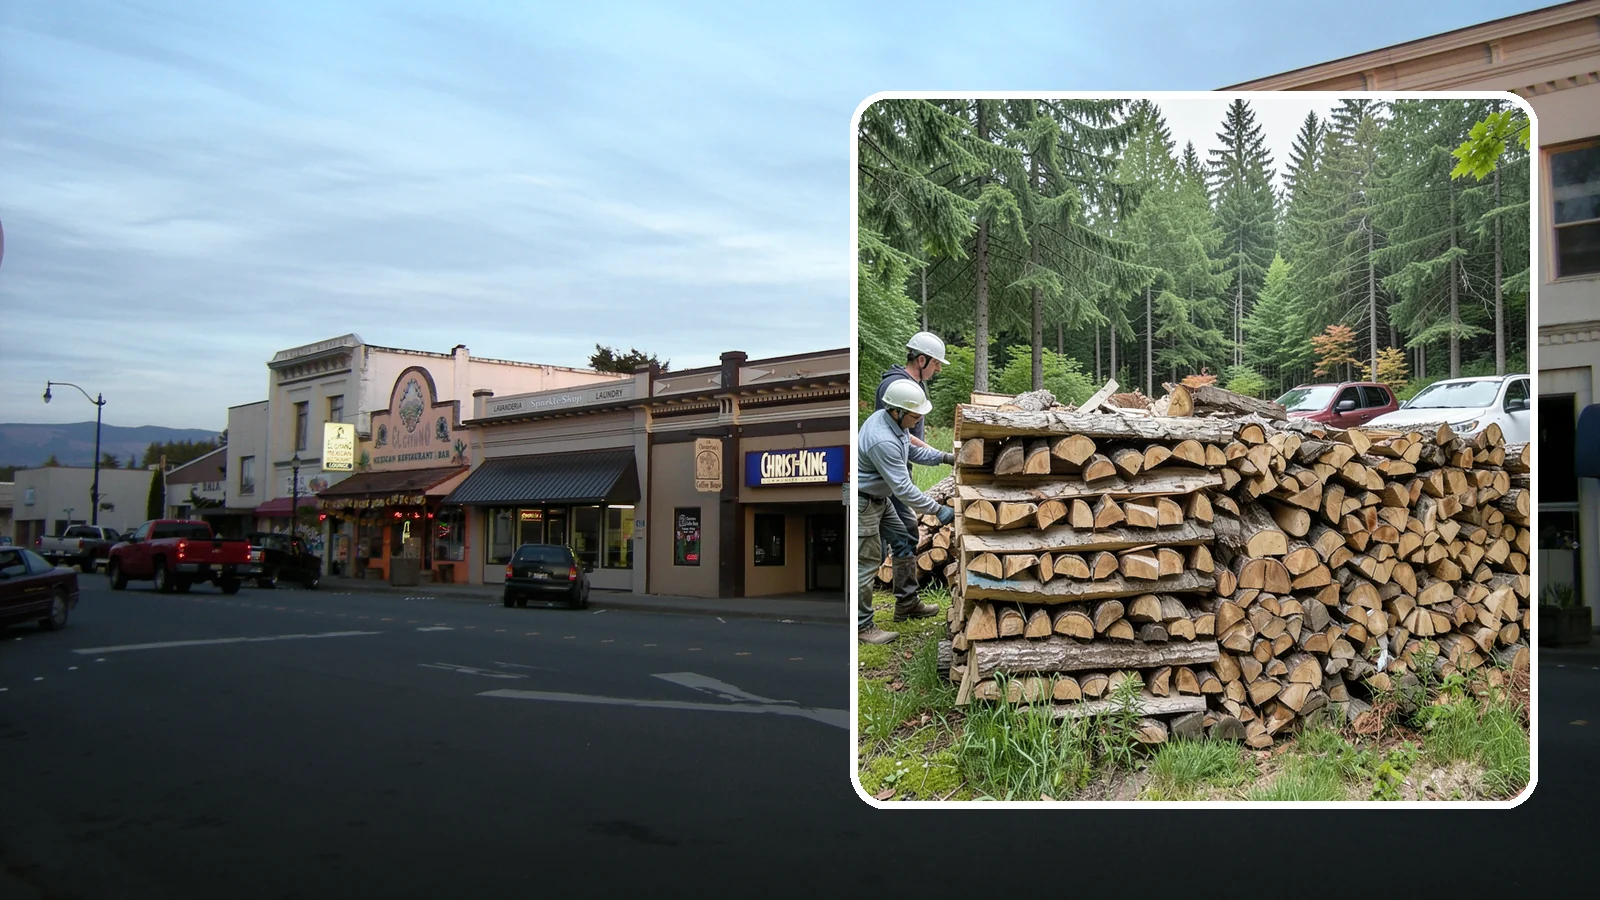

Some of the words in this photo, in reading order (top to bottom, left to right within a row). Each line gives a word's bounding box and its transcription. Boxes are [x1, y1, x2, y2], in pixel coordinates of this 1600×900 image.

[595, 388, 624, 400] LAUNDRY
[530, 396, 560, 409] Sparkle
[562, 394, 582, 405] Shop
[494, 403, 523, 413] LAVANDERIA
[397, 451, 434, 463] RESTAURANT
[437, 450, 450, 459] BAR
[761, 452, 797, 478] CHRIST
[799, 450, 827, 476] KING
[697, 480, 709, 489] Coffee
